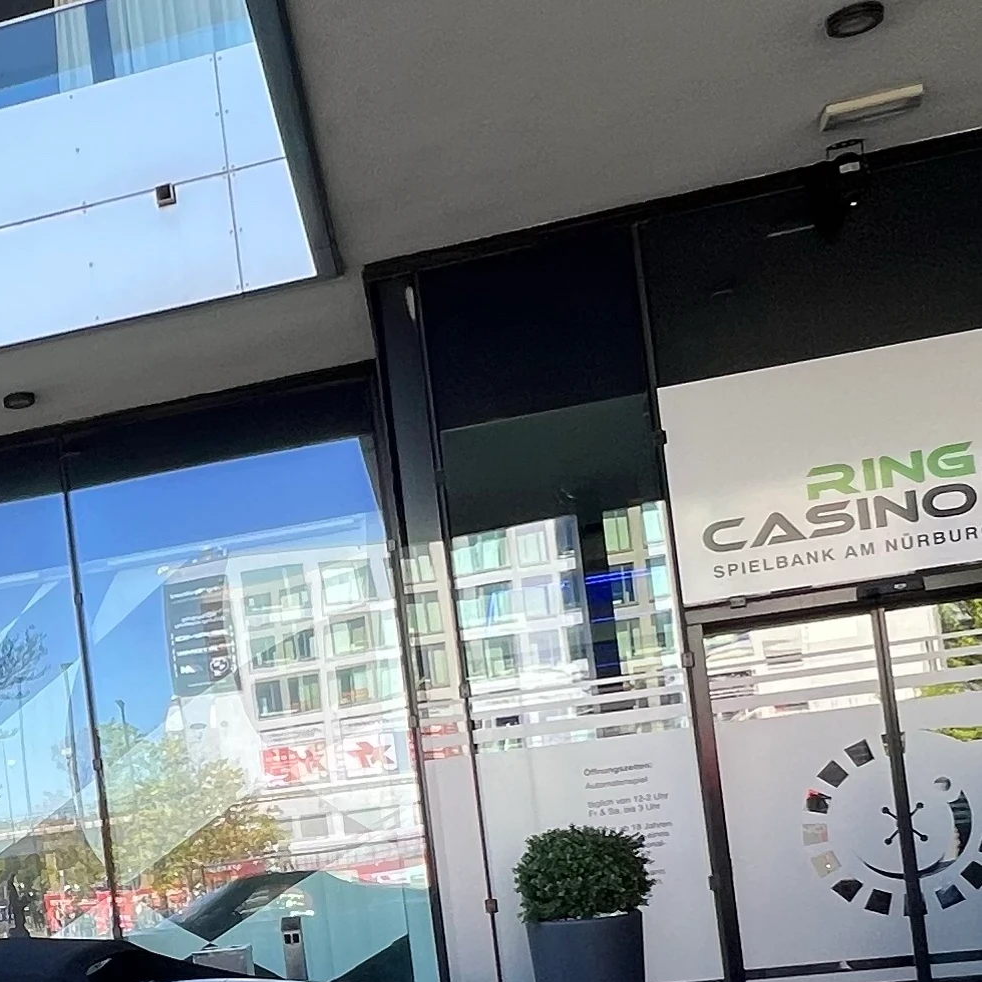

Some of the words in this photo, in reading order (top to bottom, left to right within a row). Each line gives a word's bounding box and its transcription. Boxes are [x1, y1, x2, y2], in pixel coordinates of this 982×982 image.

[805, 440, 976, 500] RING
[702, 482, 977, 552] CASINO
[713, 548, 835, 578] SPIELBANK
[845, 541, 875, 559] AM
[885, 526, 982, 552] NÜRBUR
